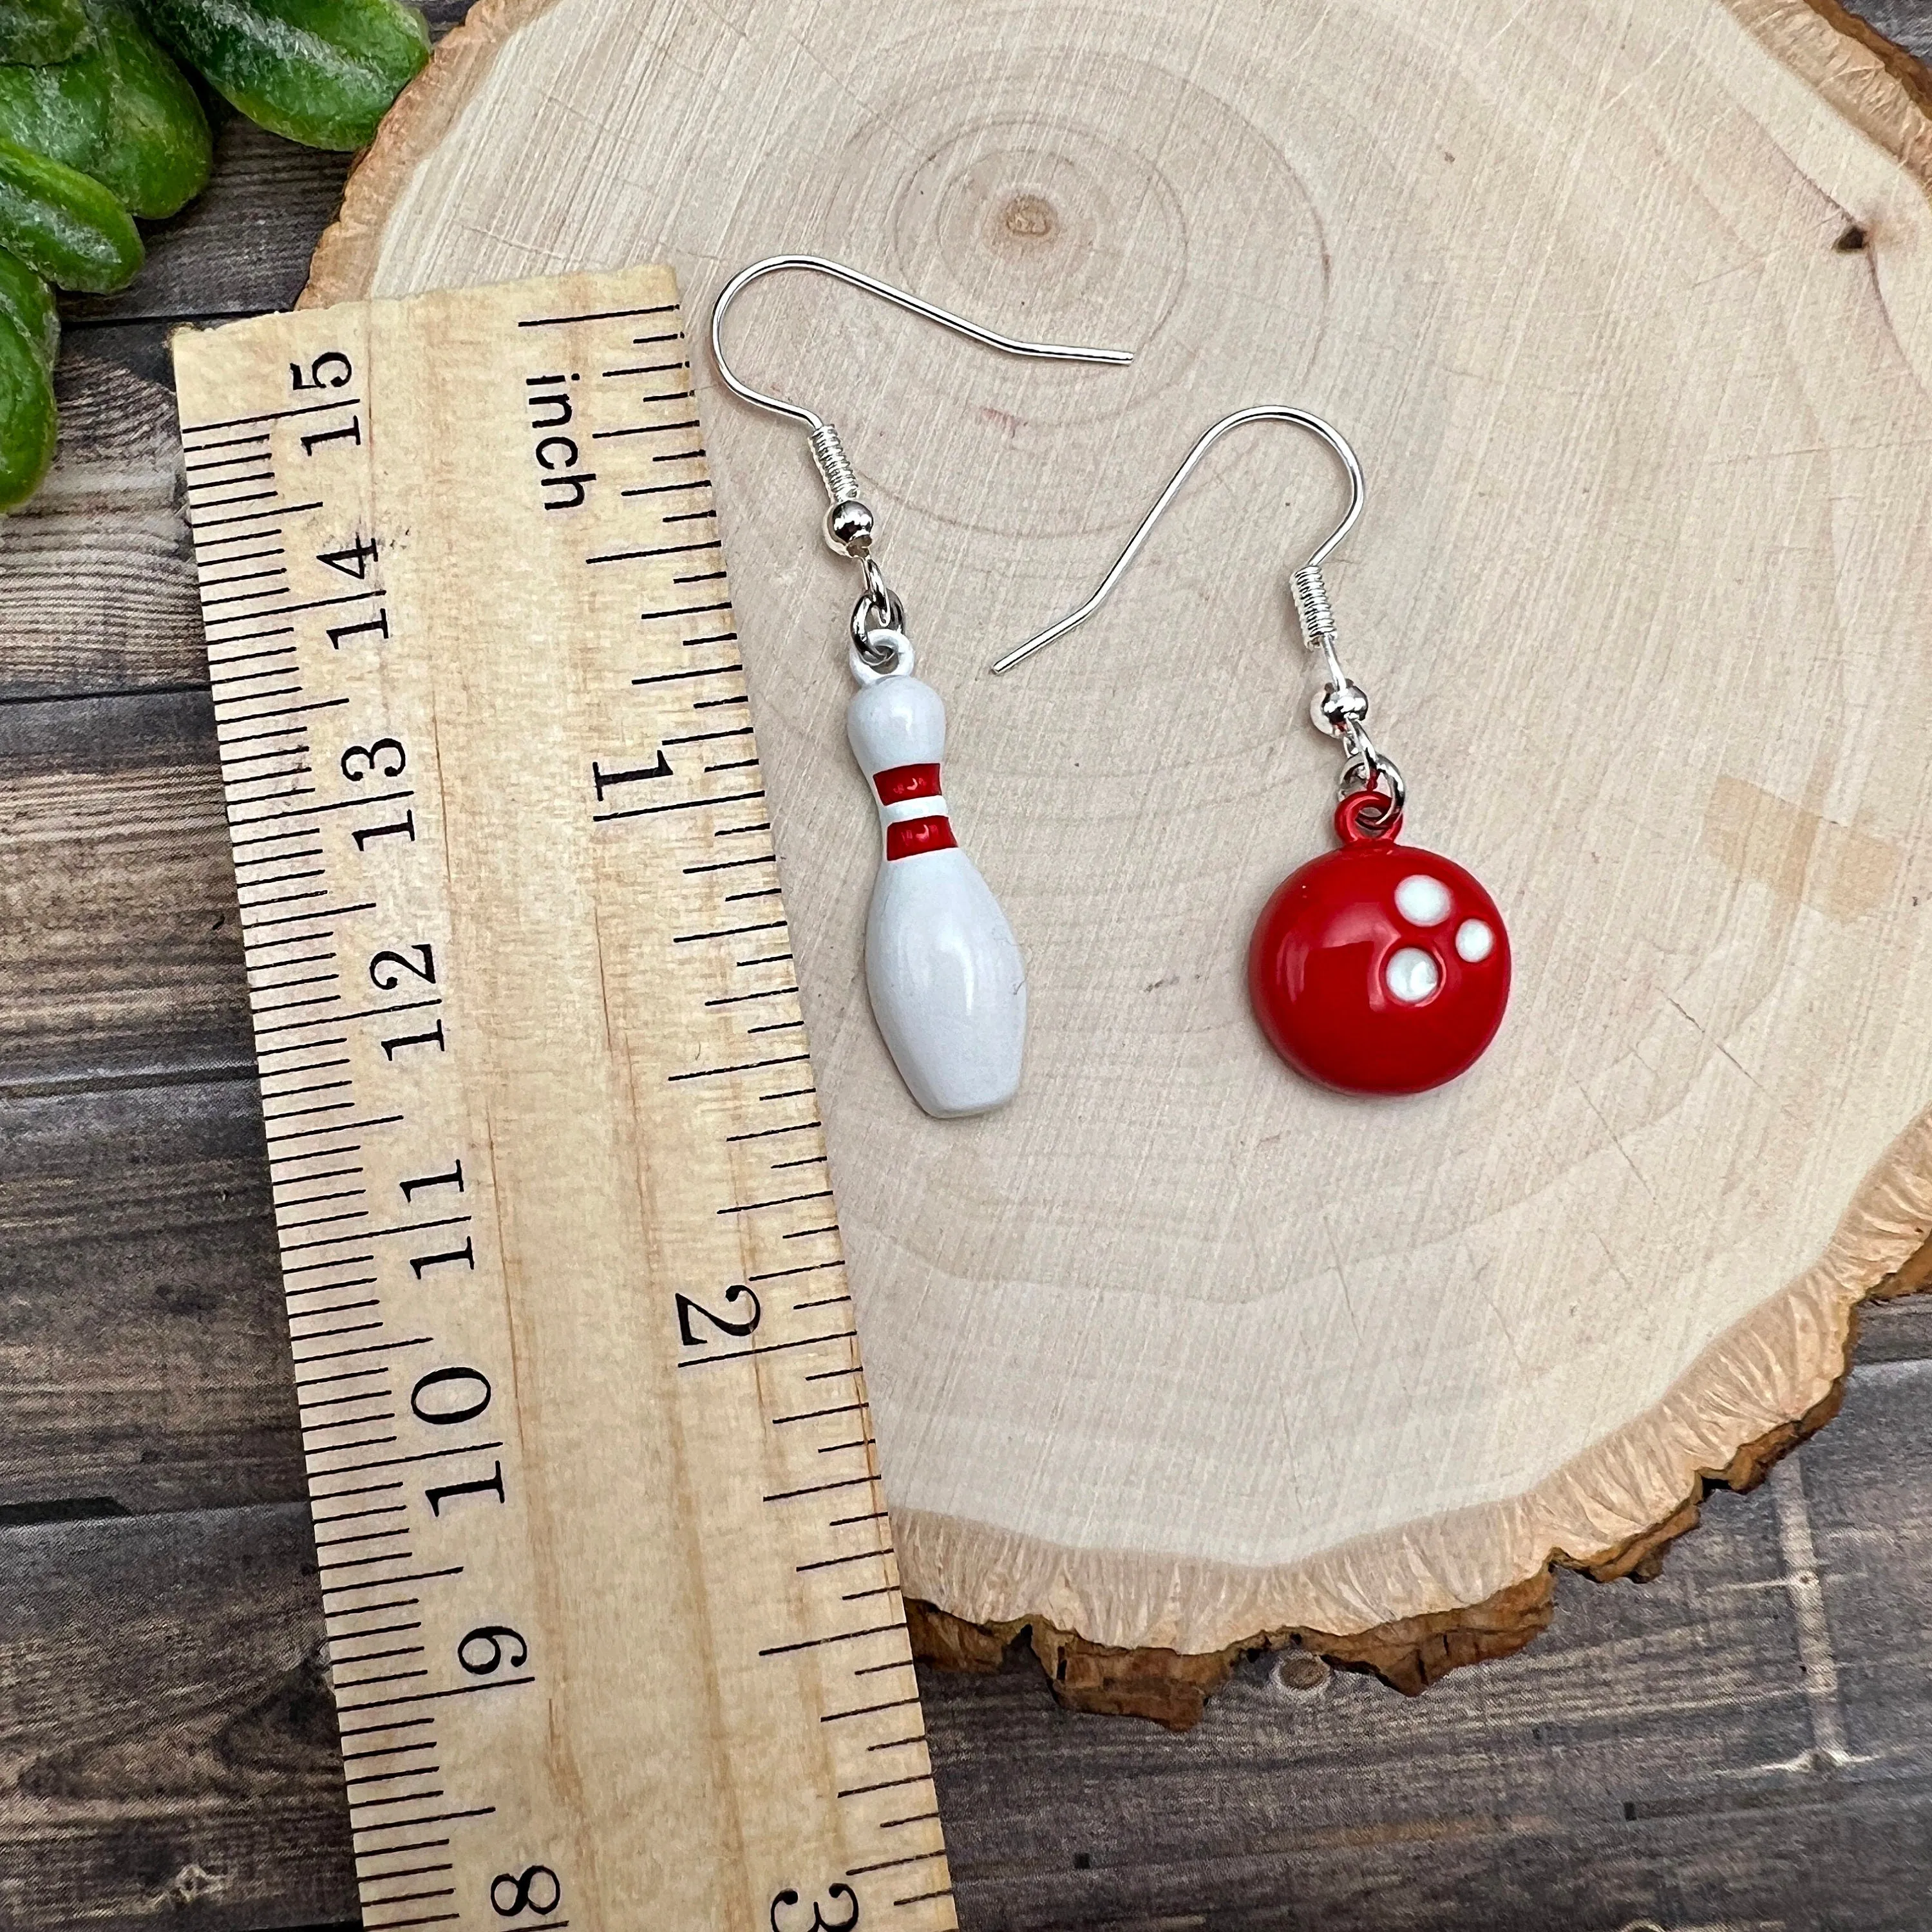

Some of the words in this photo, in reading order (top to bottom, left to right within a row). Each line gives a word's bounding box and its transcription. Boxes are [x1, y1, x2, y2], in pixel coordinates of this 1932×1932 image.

[289, 352, 361, 457] 15
[526, 373, 597, 511] inch
[316, 535, 389, 650] 14
[341, 737, 415, 851] 13
[592, 750, 674, 802] 1
[369, 943, 445, 1061] 12
[399, 1159, 475, 1280] 11
[675, 1285, 761, 1346] 2
[410, 1367, 506, 1517] 10
[457, 1625, 527, 1676] 9
[490, 1864, 561, 1917] 8
[770, 1882, 859, 1932] 3
